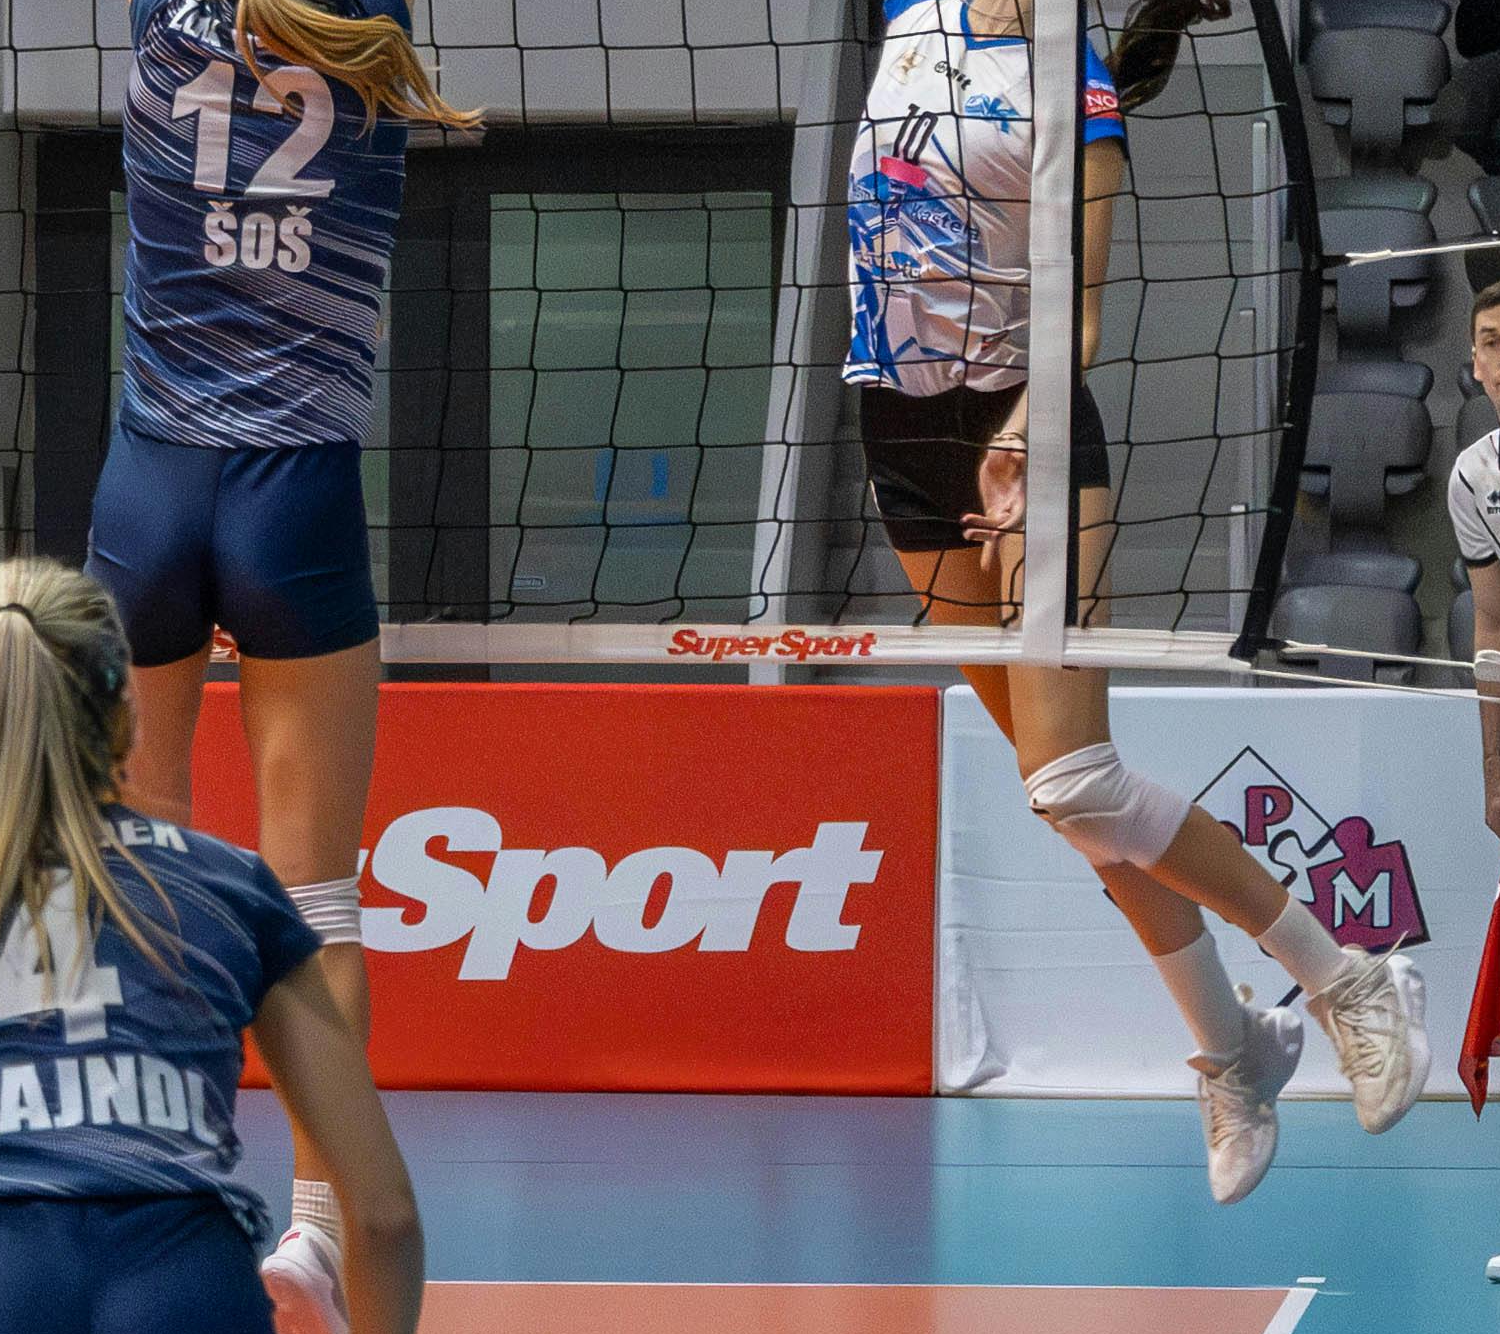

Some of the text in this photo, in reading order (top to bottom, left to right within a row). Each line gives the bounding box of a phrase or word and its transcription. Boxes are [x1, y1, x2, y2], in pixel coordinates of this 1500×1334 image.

[171, 61, 336, 199] 12
[892, 103, 939, 166] 10
[205, 201, 313, 273] ŠOŠ
[667, 629, 879, 662] SuperSport
